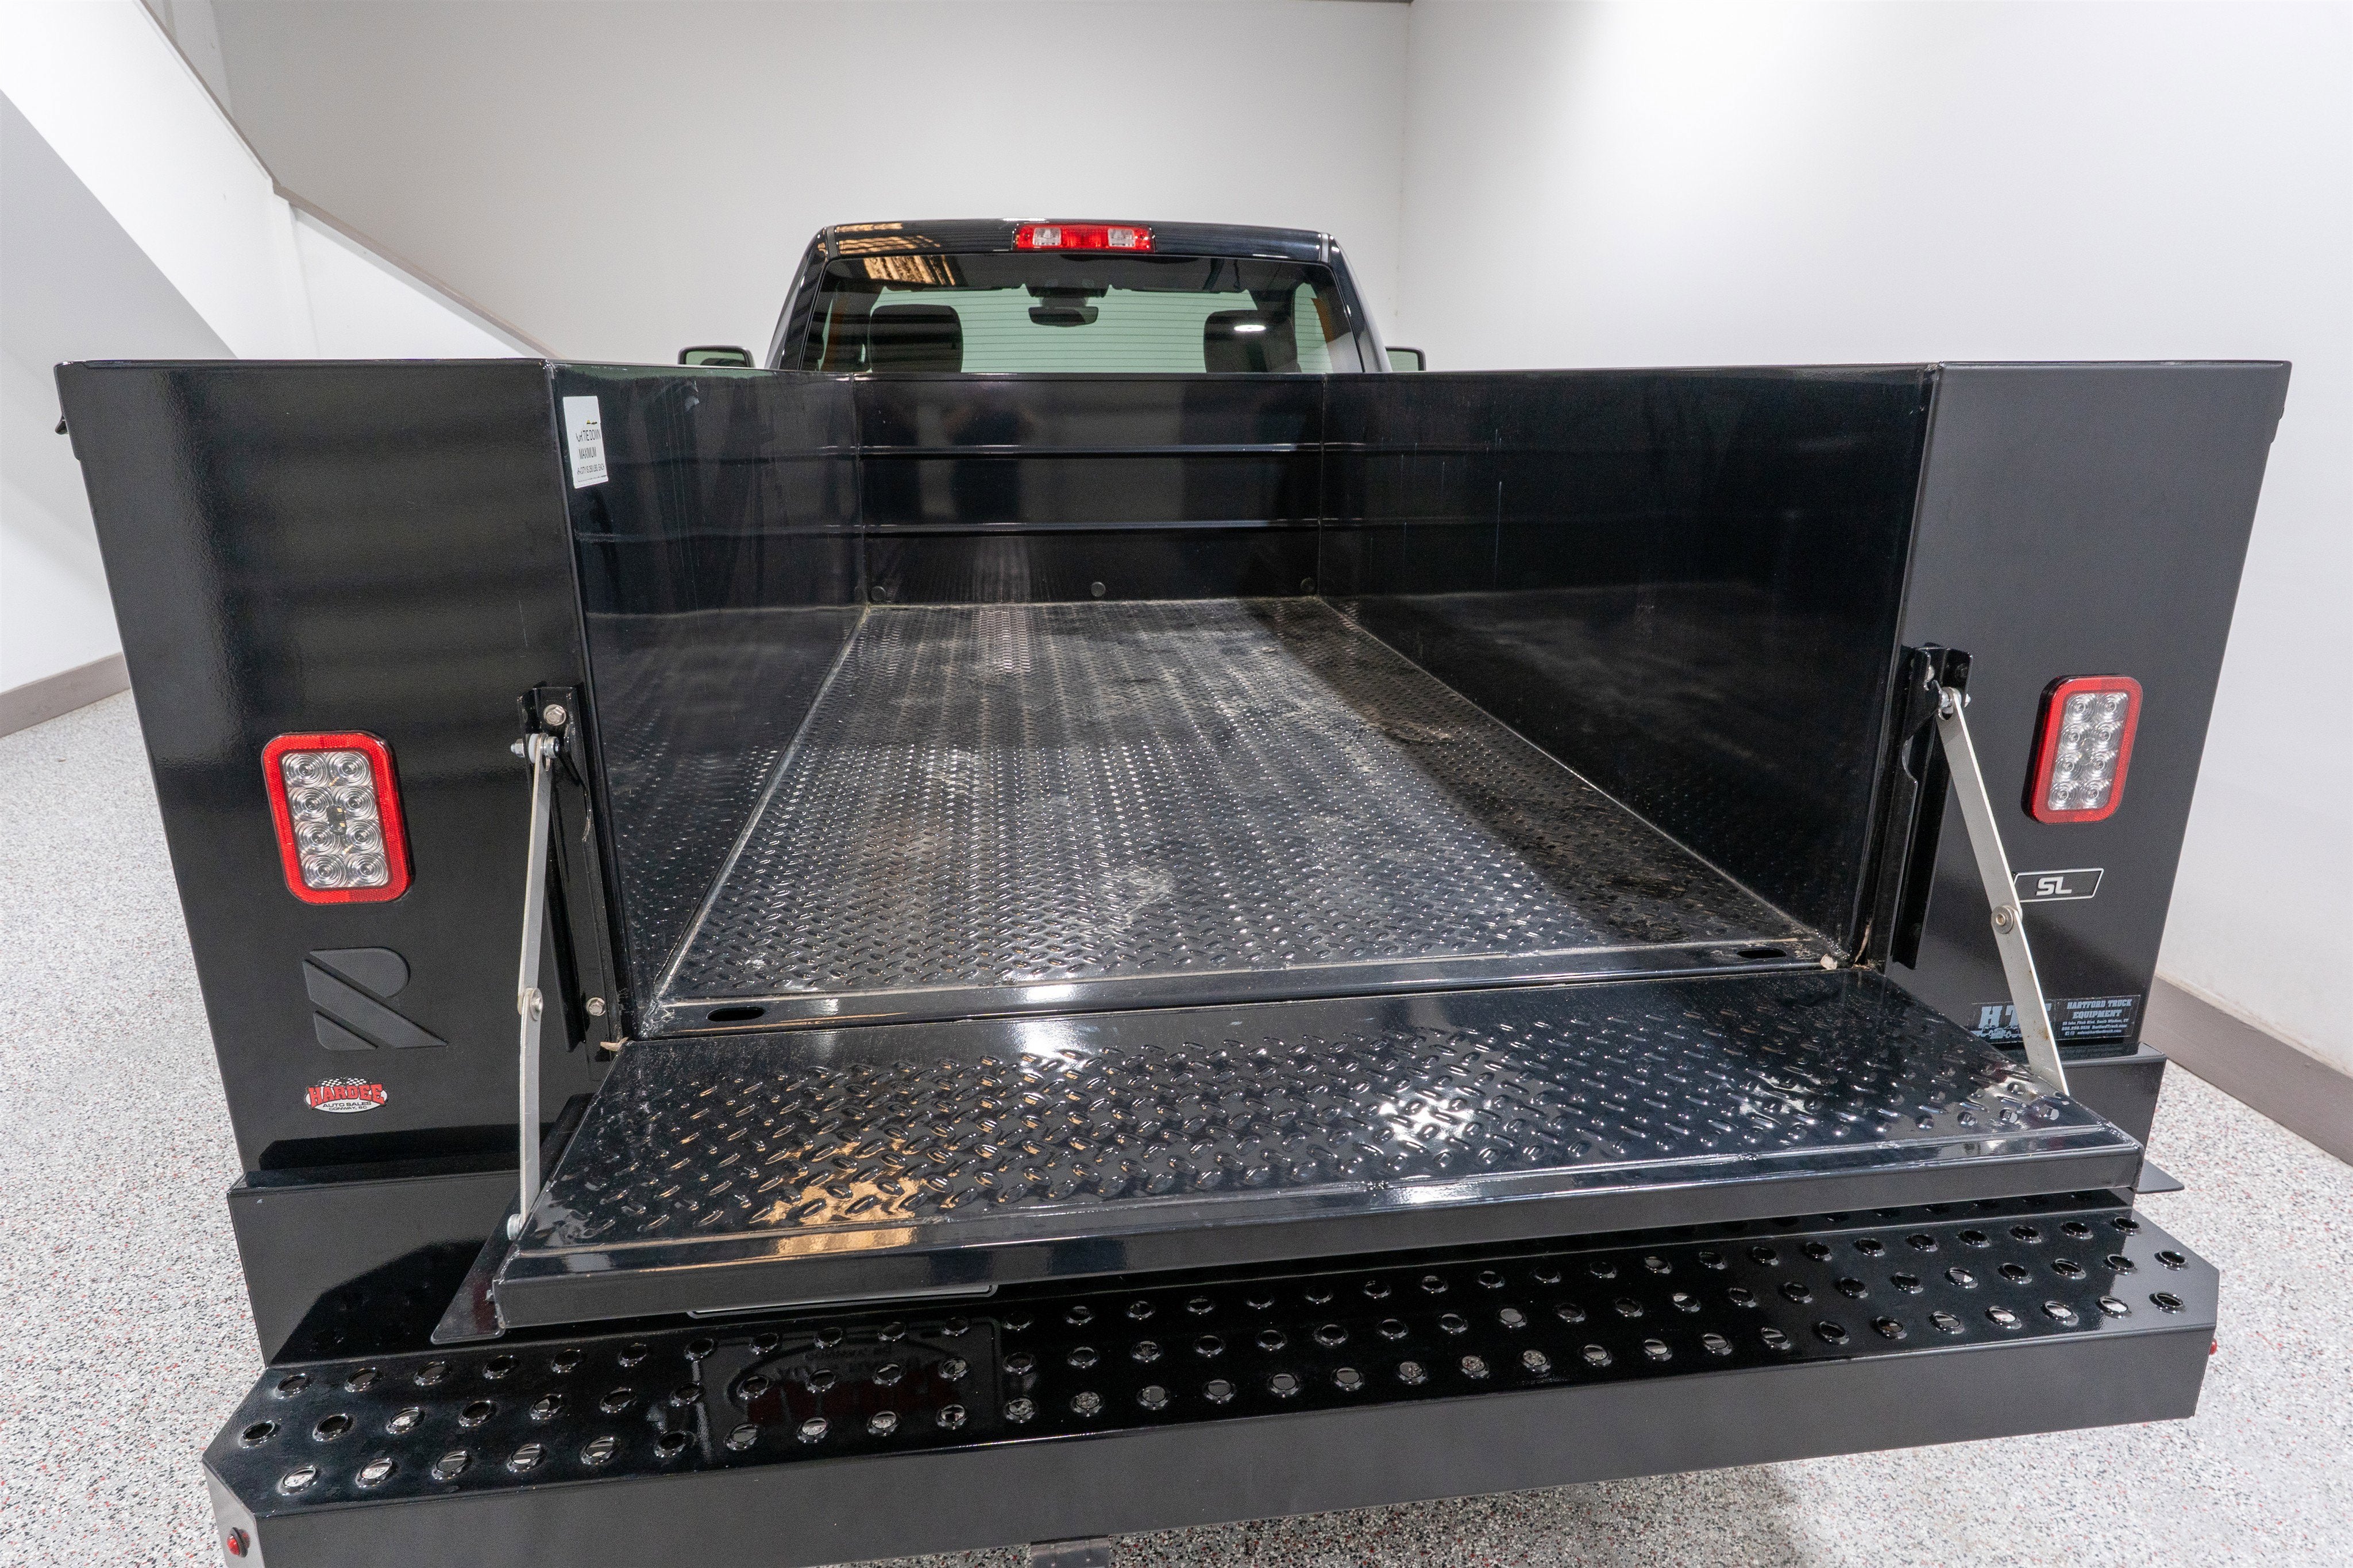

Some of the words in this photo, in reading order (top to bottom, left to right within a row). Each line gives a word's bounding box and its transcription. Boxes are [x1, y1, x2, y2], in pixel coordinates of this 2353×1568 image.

[589, 428, 601, 441] DOWN
[578, 446, 597, 459] MAXIMUM
[2036, 876, 2072, 896] SL
[2067, 1001, 2106, 1009] HARTFORD
[2108, 999, 2132, 1007] TRUCK
[2073, 1009, 2123, 1019] EQUIPMENT
[308, 1083, 385, 1109] HARDEE
